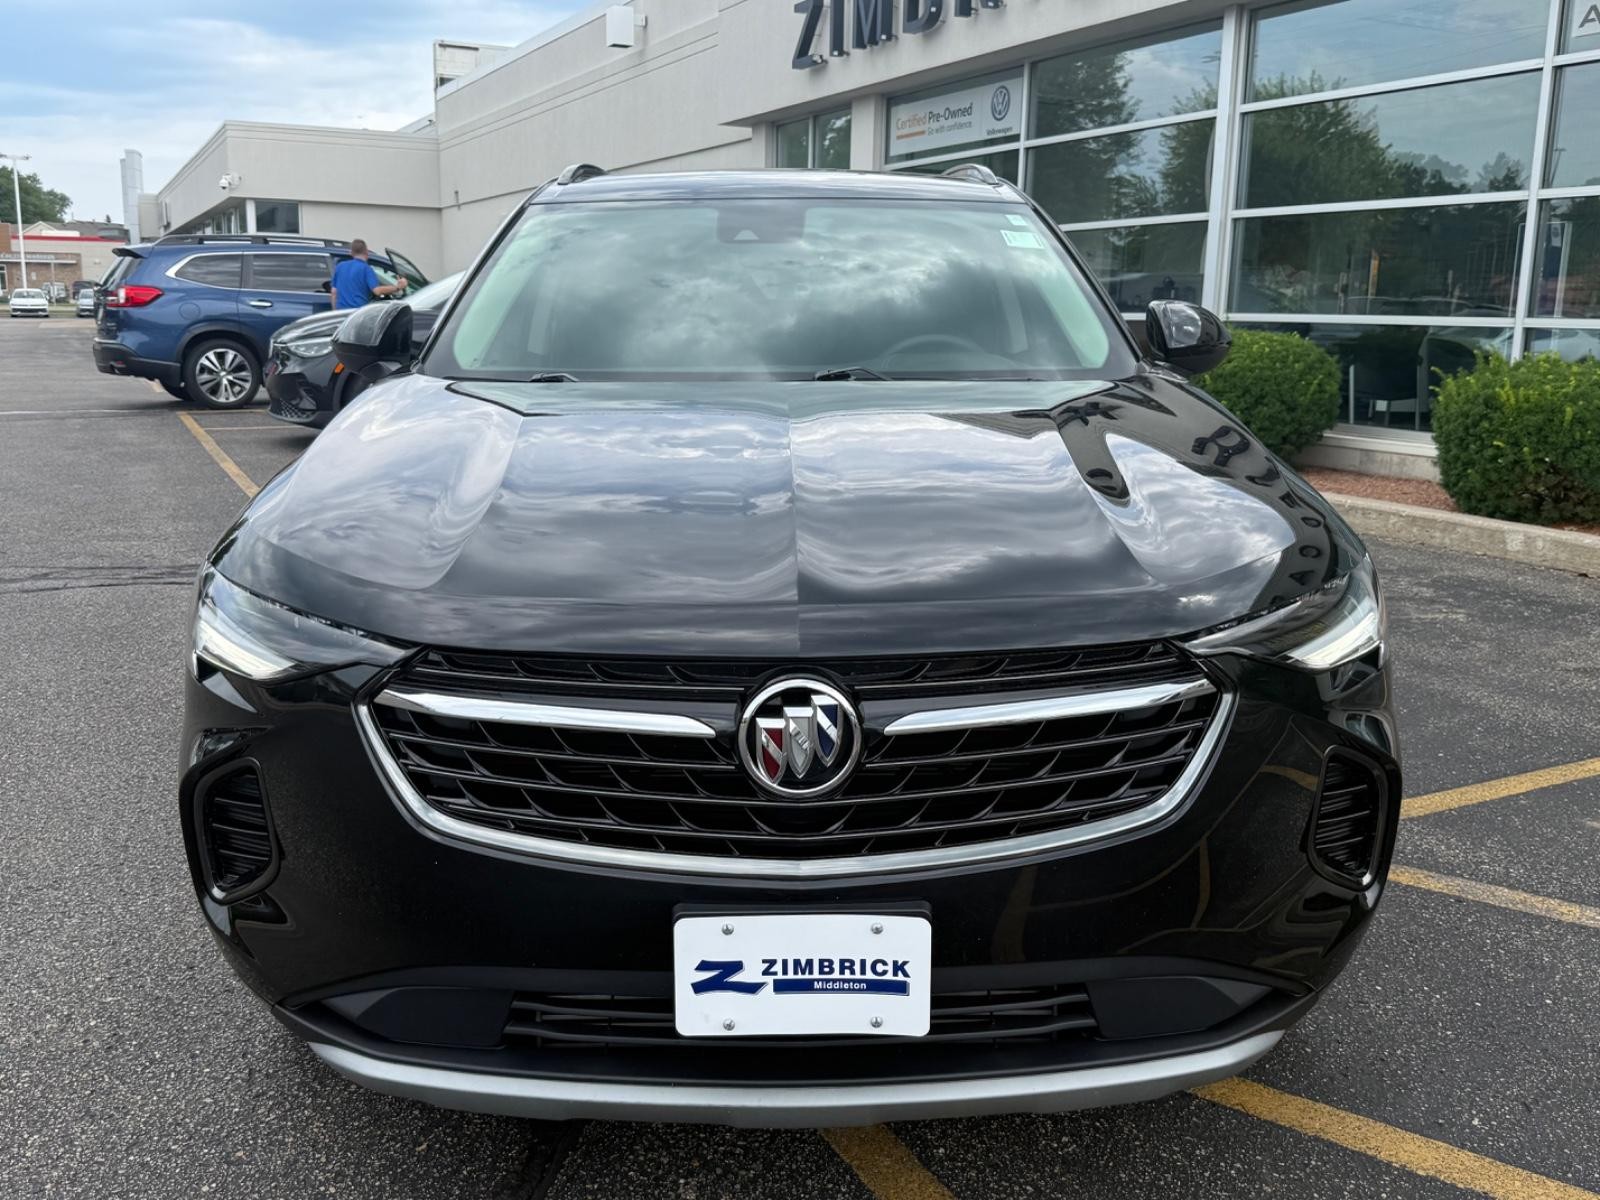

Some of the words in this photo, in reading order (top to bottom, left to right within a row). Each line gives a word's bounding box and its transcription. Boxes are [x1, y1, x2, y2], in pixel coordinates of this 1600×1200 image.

[792, 0, 1002, 69] ZIM
[896, 112, 927, 130] Certified
[928, 104, 973, 123] Pre-Owned
[986, 126, 1013, 136] Volkswagen
[761, 958, 911, 978] ZIMBRICK
[813, 980, 867, 990] Middleton
